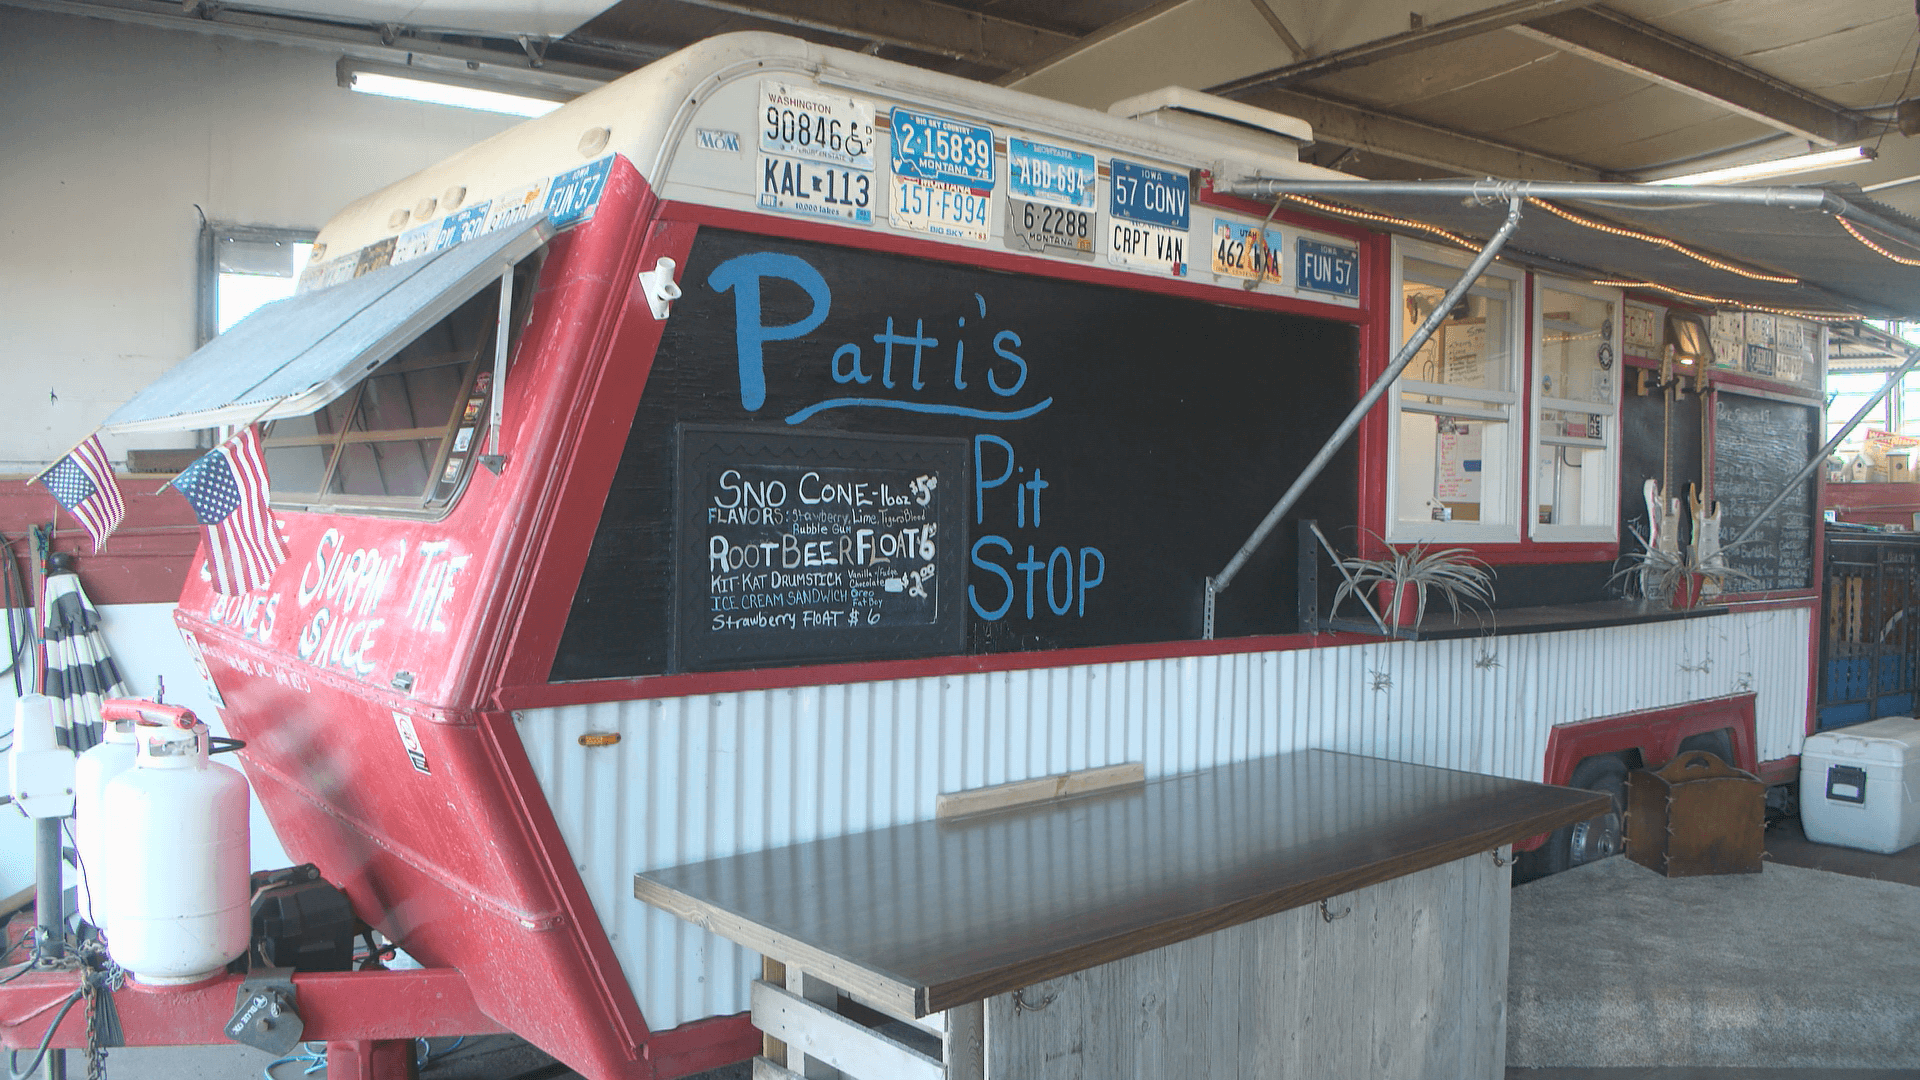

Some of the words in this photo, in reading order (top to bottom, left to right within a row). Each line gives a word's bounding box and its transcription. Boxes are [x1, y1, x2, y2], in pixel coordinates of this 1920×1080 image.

[768, 93, 831, 114] WASHINGTON
[915, 116, 927, 126] BIG
[928, 119, 942, 129] SKY
[943, 123, 971, 135] COUNTRY
[919, 158, 969, 176] MONTANA
[1141, 169, 1162, 181] IOWA
[764, 158, 810, 198] KAL
[824, 169, 870, 208] 113
[549, 182, 579, 217] FUN
[575, 174, 601, 210] 57
[1116, 175, 1138, 206] 57
[1144, 181, 1186, 217] CONV
[819, 206, 840, 216] lakes
[930, 226, 944, 235] BIG
[946, 227, 963, 237] SKY
[1028, 232, 1073, 247] MONTANA
[1239, 229, 1257, 239] UTAH
[1114, 225, 1150, 257] CRPT
[1157, 233, 1183, 263] VAN
[1217, 239, 1244, 269] 462
[1320, 245, 1338, 255] IOWA
[1304, 253, 1332, 284] FUN
[1335, 258, 1352, 286] 57
[708, 252, 1028, 411] Patti's
[974, 434, 1049, 528] Pit
[793, 523, 828, 536] Bubble
[405, 539, 473, 634] THE
[771, 570, 842, 589] DRUMSTICK
[848, 568, 872, 579] Vanilla
[849, 578, 885, 588] Chocolate
[710, 595, 739, 612] ICE
[741, 592, 784, 610] CREAM
[786, 587, 847, 606] SANDWICH
[851, 588, 874, 597] Oreo
[853, 598, 868, 607] Fat
[868, 597, 882, 608] Boy
[712, 611, 796, 631] Strawberry
[298, 606, 385, 678] SAUCE
[241, 1005, 258, 1024] BLUE
